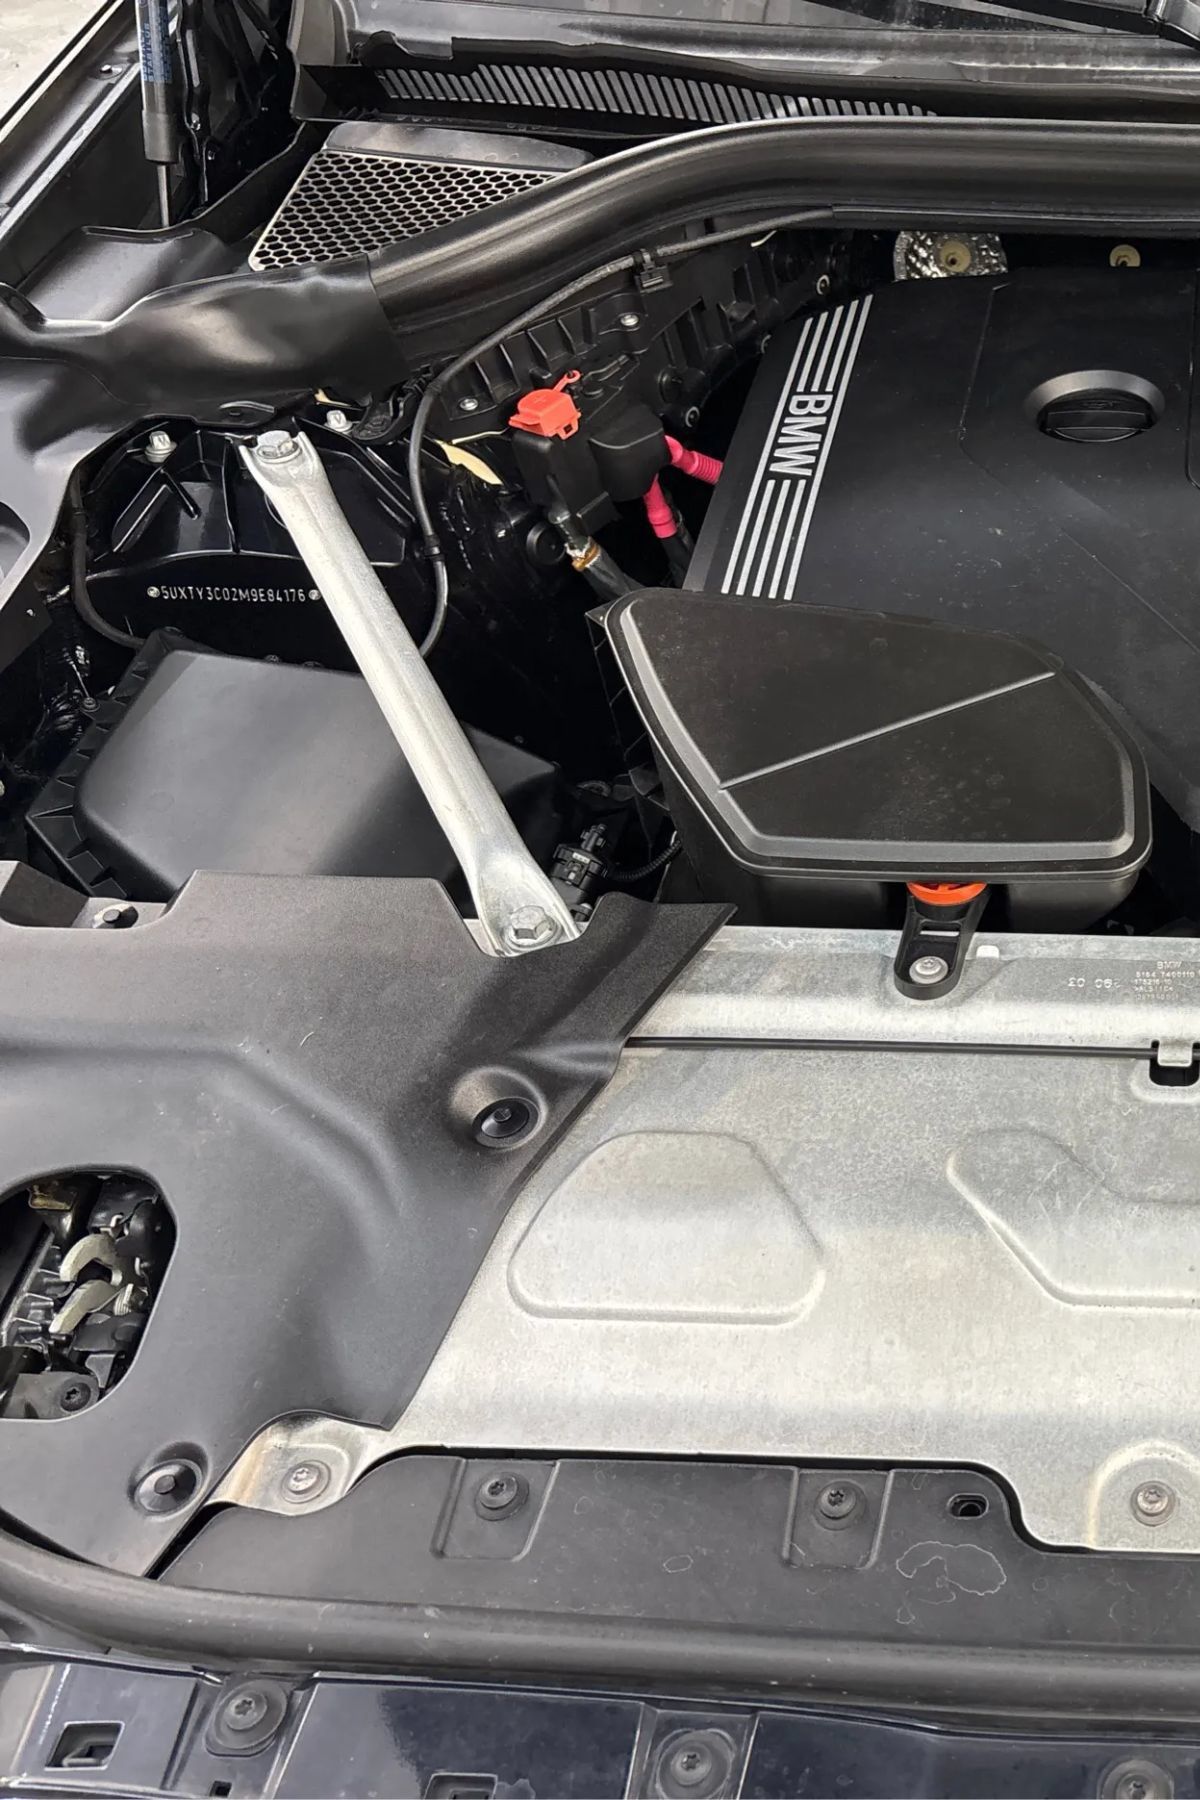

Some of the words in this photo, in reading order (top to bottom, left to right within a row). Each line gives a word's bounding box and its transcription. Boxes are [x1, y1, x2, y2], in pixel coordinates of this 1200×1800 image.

[769, 394, 834, 476] BMW
[160, 585, 307, 602] 5UXTY3C02M9E84176
[1157, 961, 1182, 970] BMW
